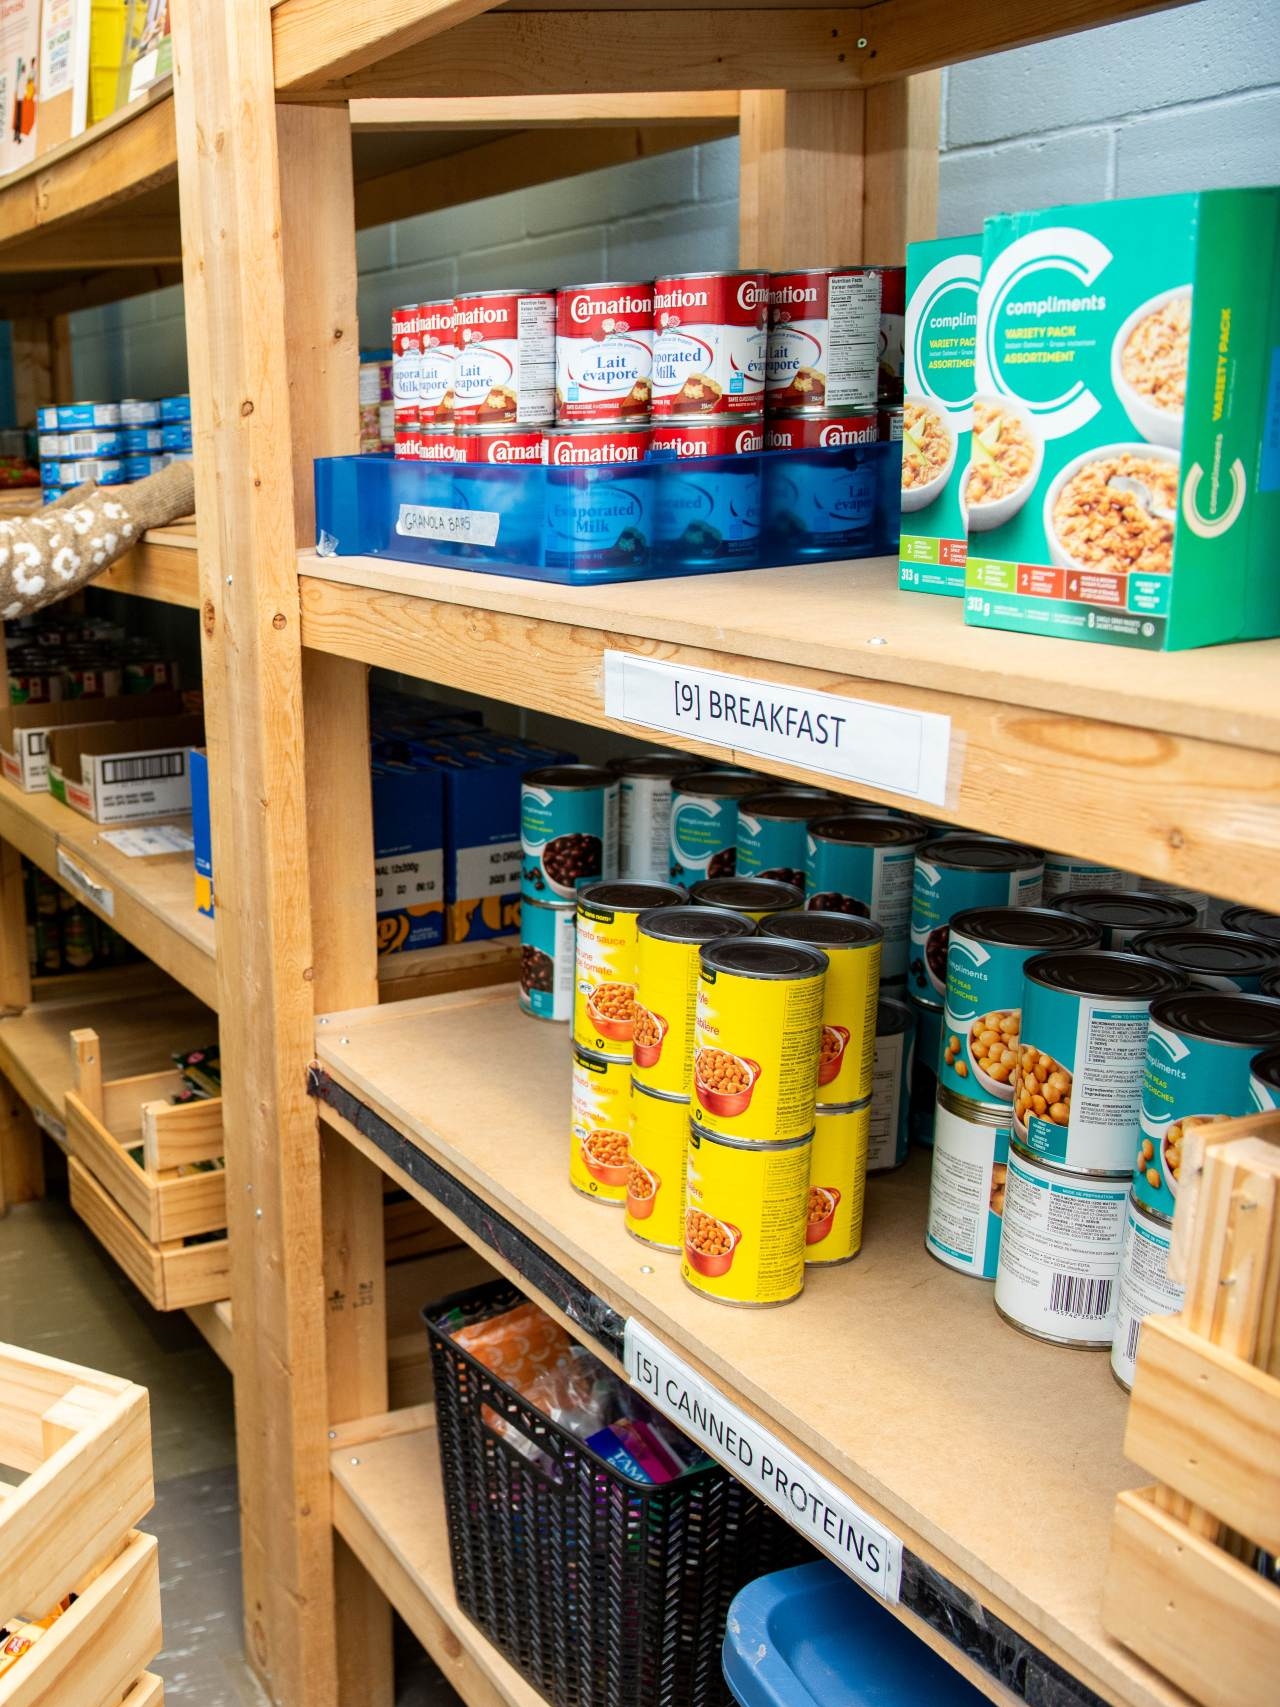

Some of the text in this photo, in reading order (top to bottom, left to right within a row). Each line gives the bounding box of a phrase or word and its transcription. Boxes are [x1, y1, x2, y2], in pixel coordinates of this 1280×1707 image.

[570, 295, 651, 323] Carnation
[1005, 293, 1107, 318] compliments
[930, 312, 976, 330] complim
[1004, 325, 1076, 340] VARIETY PACK
[929, 337, 976, 348] VARIETY PAC
[597, 356, 626, 369] Lait
[928, 359, 976, 369] ASSORTIMEN
[1003, 351, 1075, 364] ASSORTIMENT
[1211, 308, 1231, 421] VARIETY PACK
[460, 365, 481, 377] Lait
[582, 370, 639, 384] évaporé
[819, 425, 879, 448] Carnatio
[553, 441, 638, 465] Carnation
[1209, 433, 1224, 514] compliments
[404, 512, 445, 530] GRANOLA
[575, 519, 610, 533] Milk
[901, 568, 913, 581] 313
[1069, 579, 1078, 592] 4
[674, 681, 846, 748] [9] BREAKFAST
[597, 935, 626, 946] sauce
[583, 960, 613, 976] tomate
[592, 1083, 619, 1096] sauce
[636, 1351, 880, 1574] [5] CANNED PROTEINS
